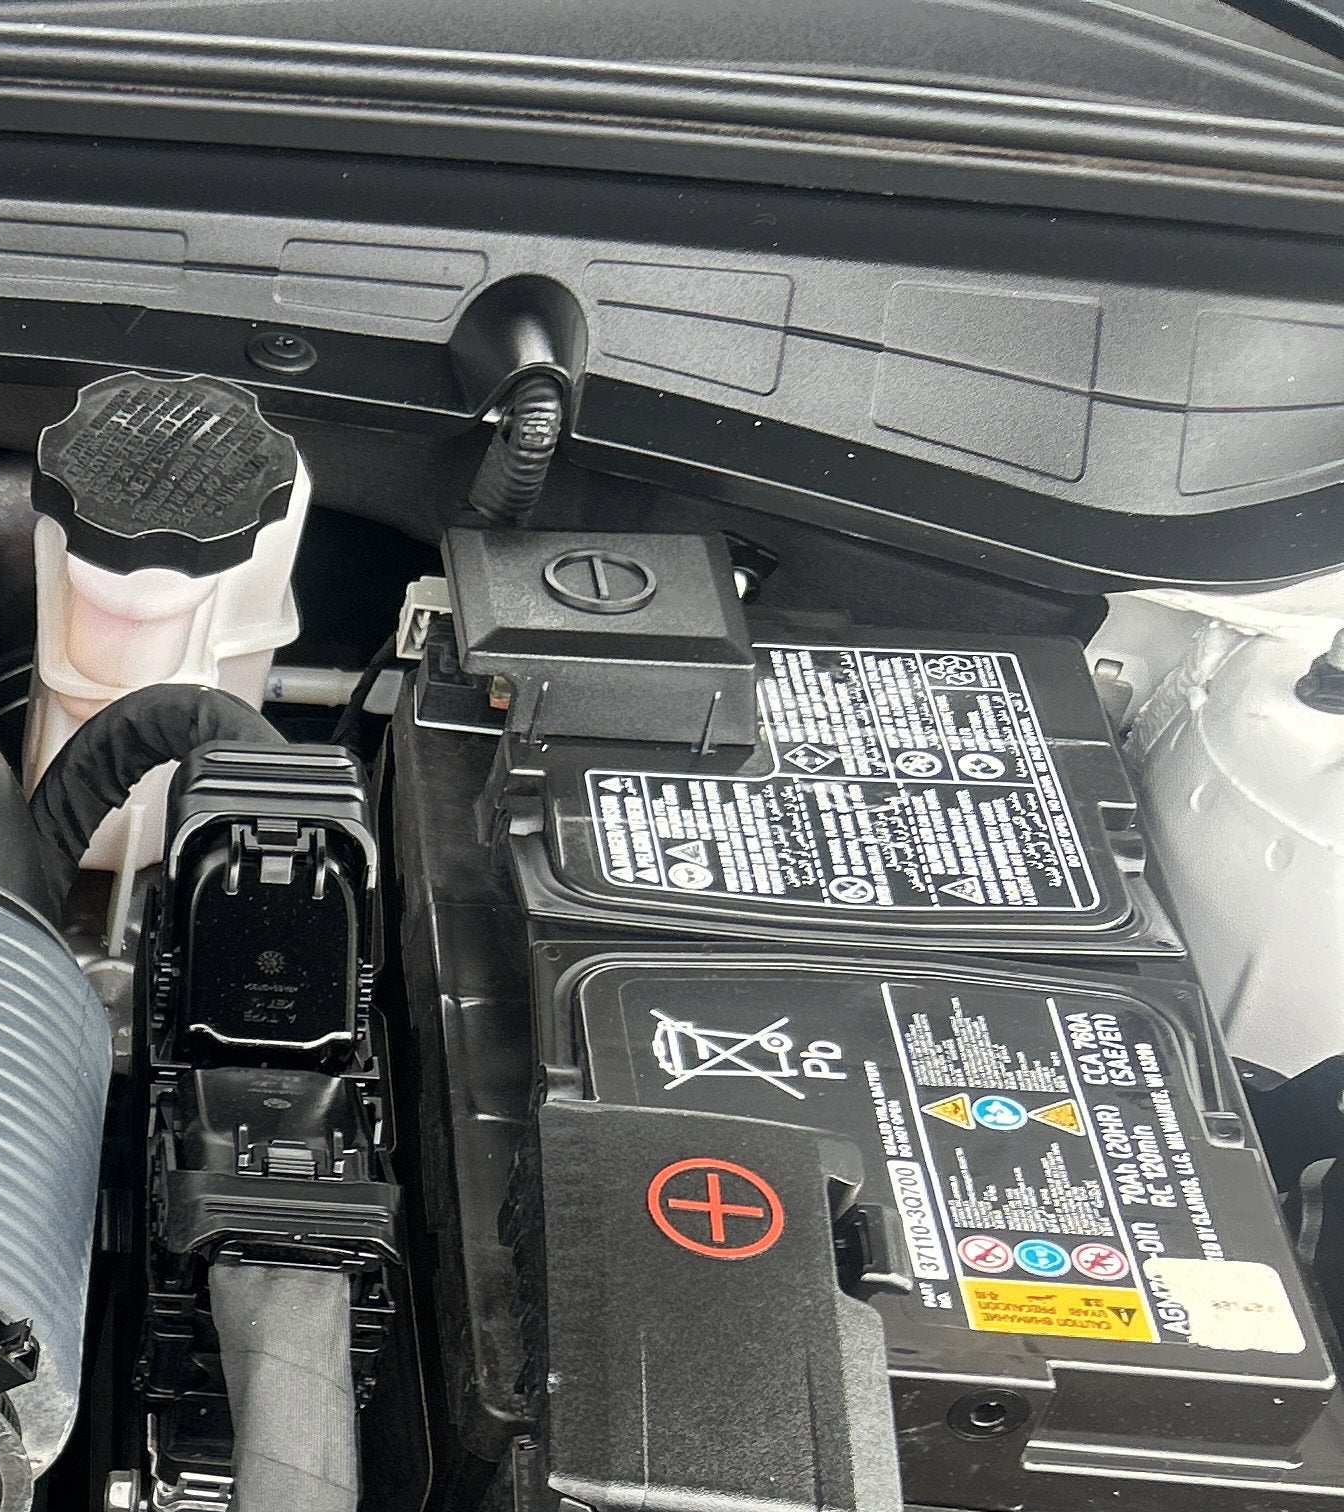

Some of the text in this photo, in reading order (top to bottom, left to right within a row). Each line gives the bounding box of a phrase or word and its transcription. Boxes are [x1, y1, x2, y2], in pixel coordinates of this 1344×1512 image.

[805, 1036, 848, 1083] Pb
[1074, 1050, 1110, 1084] CCA
[1091, 1102, 1148, 1205] 70Ah (20HR)
[1127, 1123, 1178, 1207] RC 120min
[892, 1167, 940, 1307] PART 37110-3Q700
